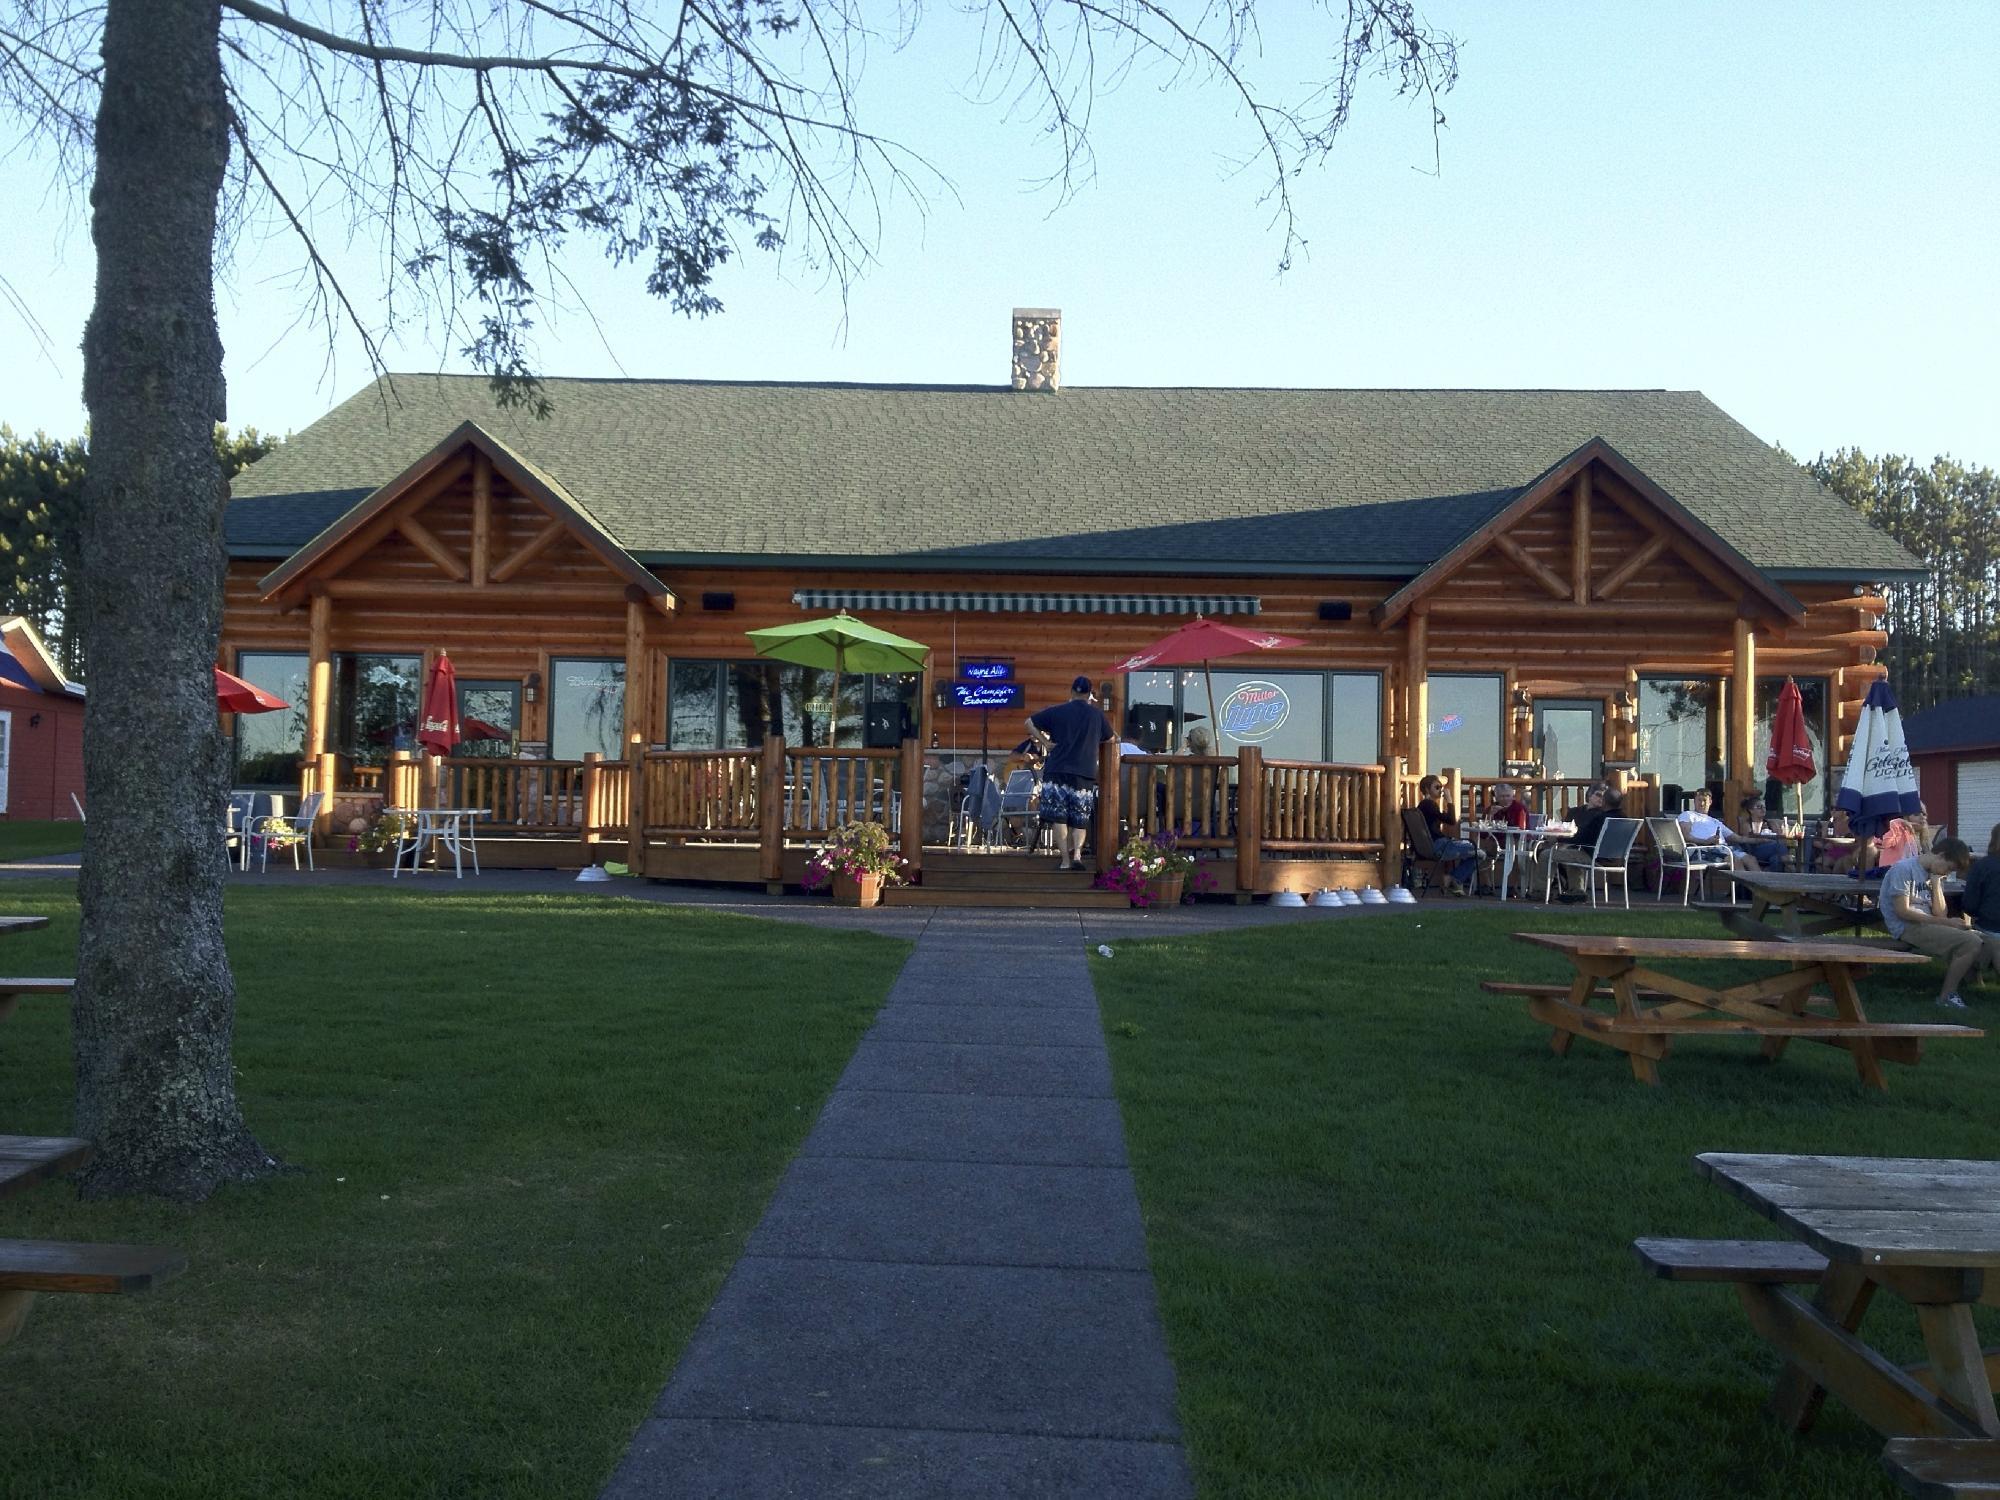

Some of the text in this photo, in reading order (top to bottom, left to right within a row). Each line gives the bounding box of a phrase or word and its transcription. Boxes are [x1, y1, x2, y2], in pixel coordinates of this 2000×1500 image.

[955, 686, 970, 696] The
[1238, 690, 1279, 704] Miller
[962, 696, 1008, 705] Experience
[1223, 702, 1285, 732] Lite
